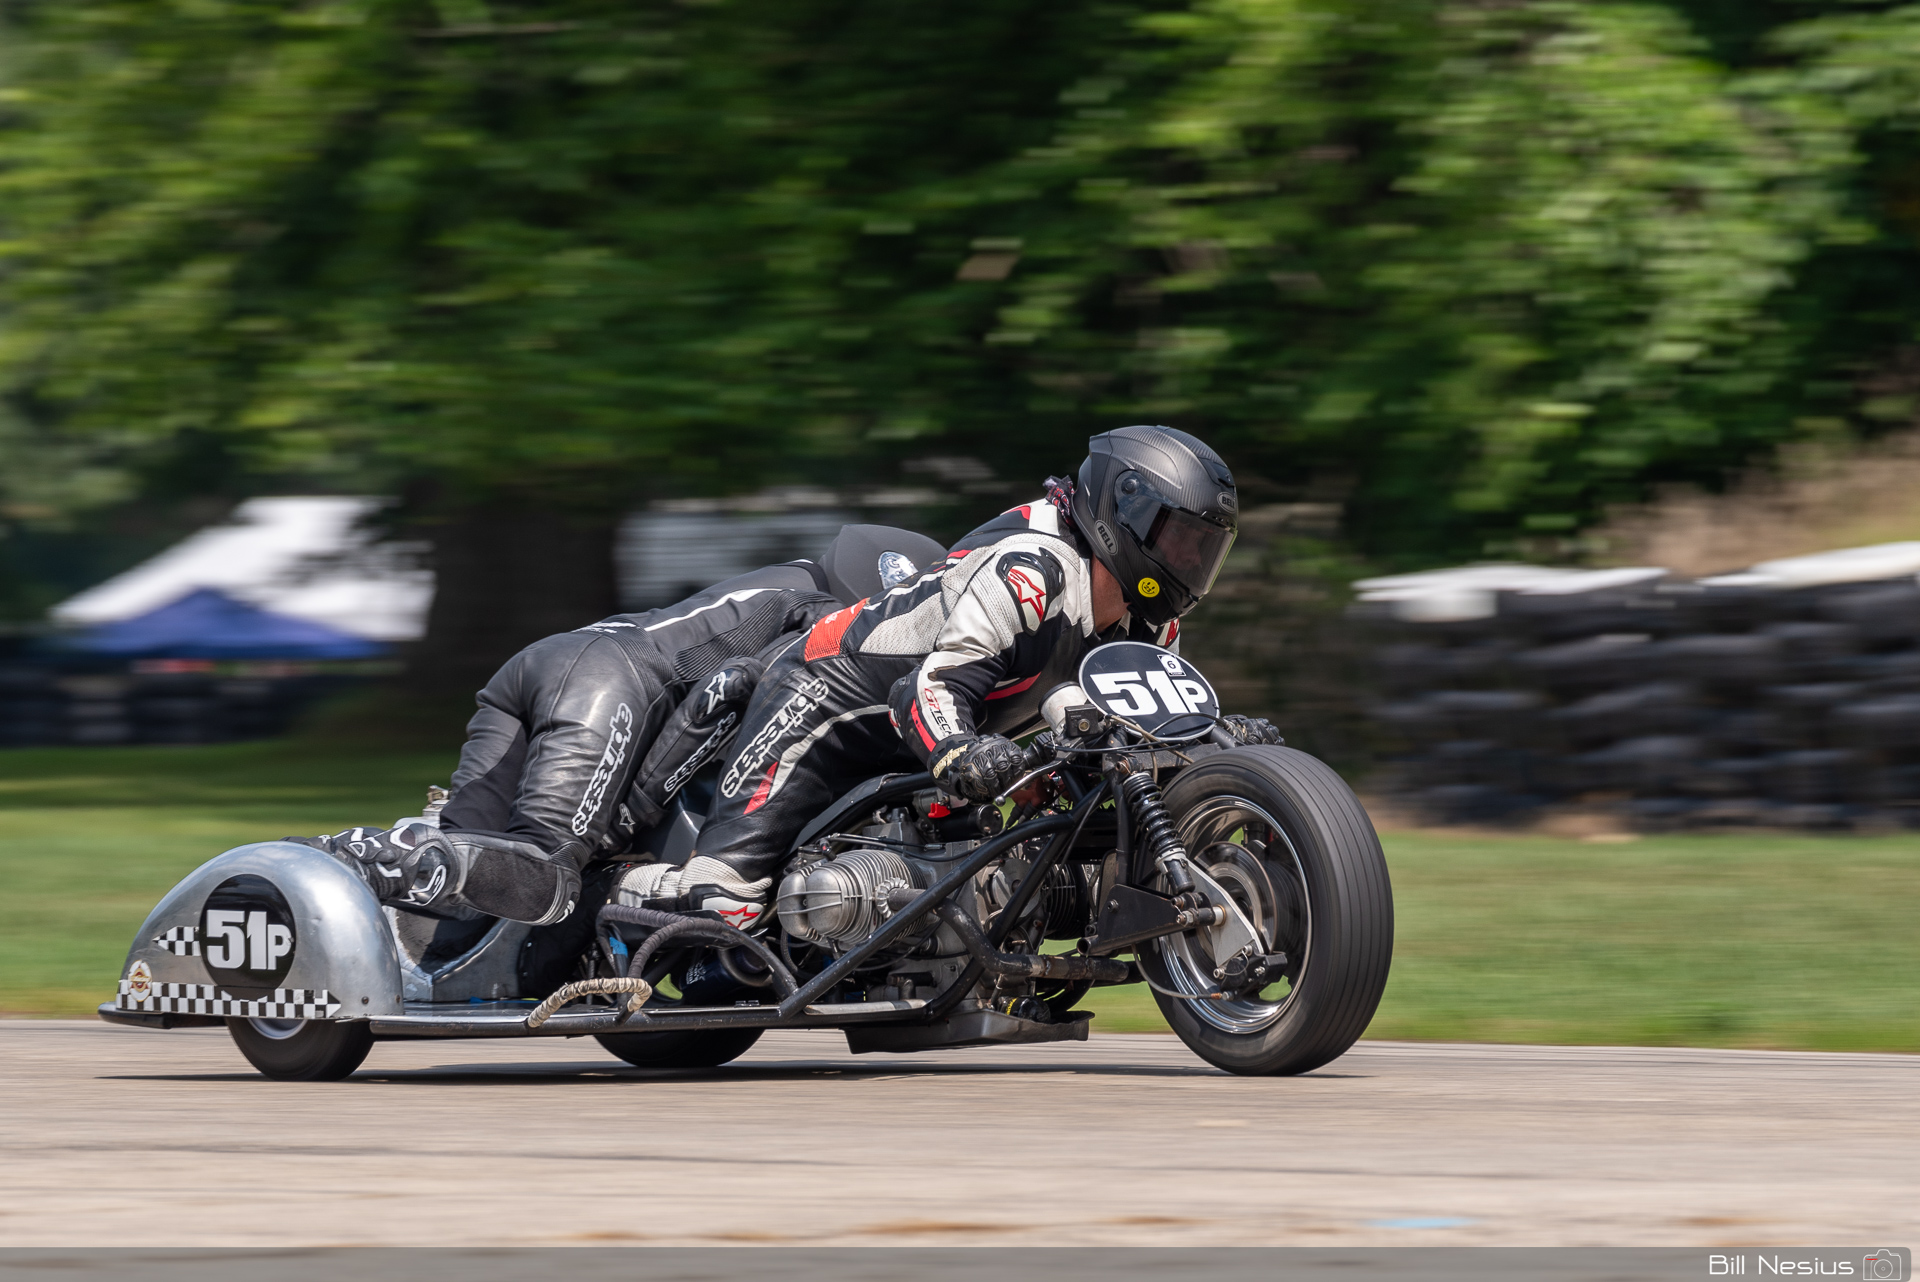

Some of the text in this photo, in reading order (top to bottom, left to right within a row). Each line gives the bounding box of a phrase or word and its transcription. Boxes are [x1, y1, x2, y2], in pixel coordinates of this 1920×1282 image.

[1098, 525, 1114, 550] BELL
[1167, 660, 1176, 669] 6
[721, 677, 829, 798] alpinestars
[572, 702, 633, 836] alpinestars
[206, 909, 292, 970] 51P
